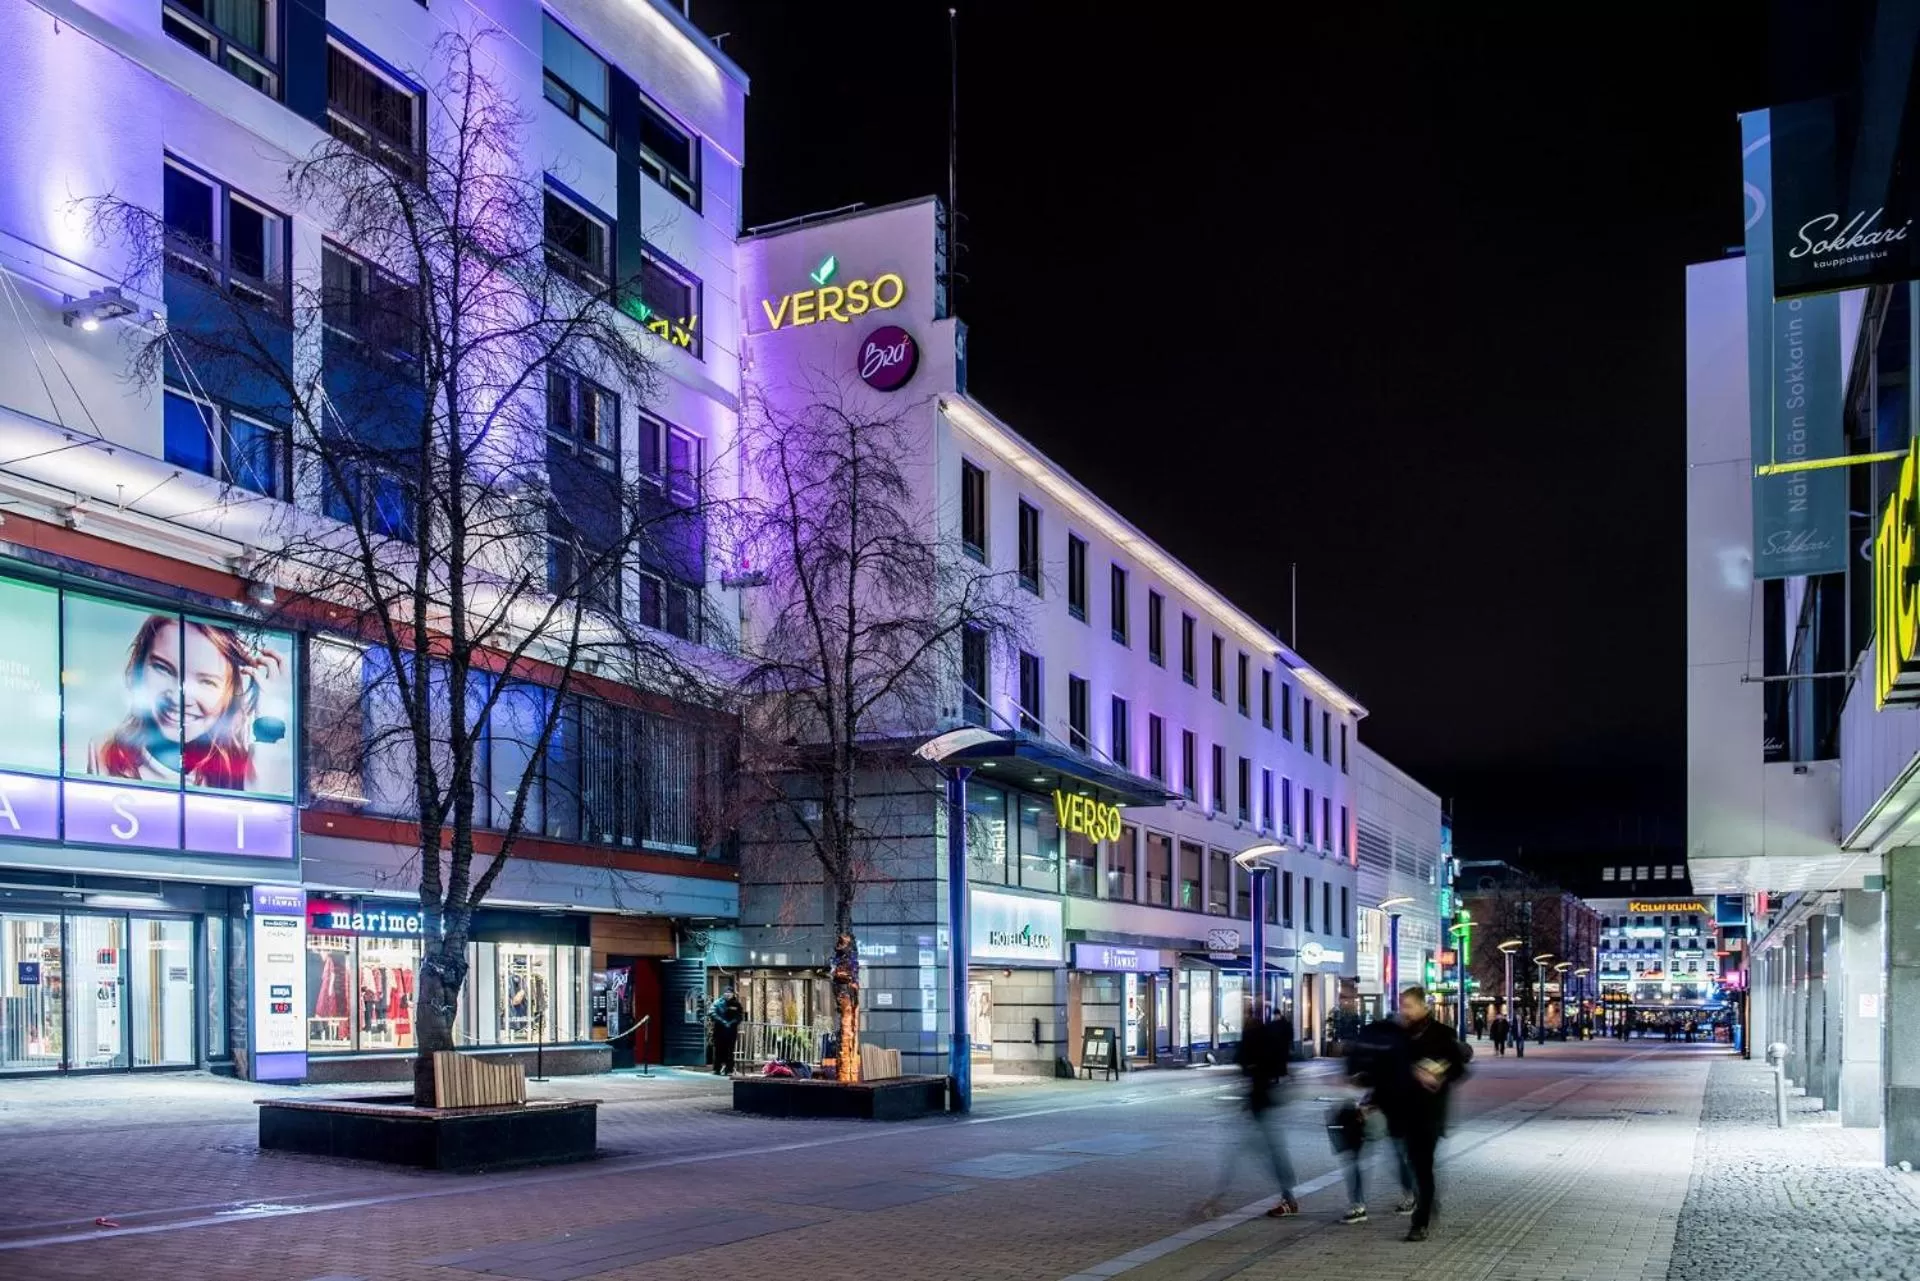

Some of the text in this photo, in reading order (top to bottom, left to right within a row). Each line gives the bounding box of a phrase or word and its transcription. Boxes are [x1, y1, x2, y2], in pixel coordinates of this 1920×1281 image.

[1789, 207, 1913, 258] Sokkari
[1813, 251, 1888, 268] kauppakeskus
[762, 273, 904, 329] VERSO
[1785, 317, 1805, 410] Sokkarin
[1053, 789, 1121, 843] VERSO
